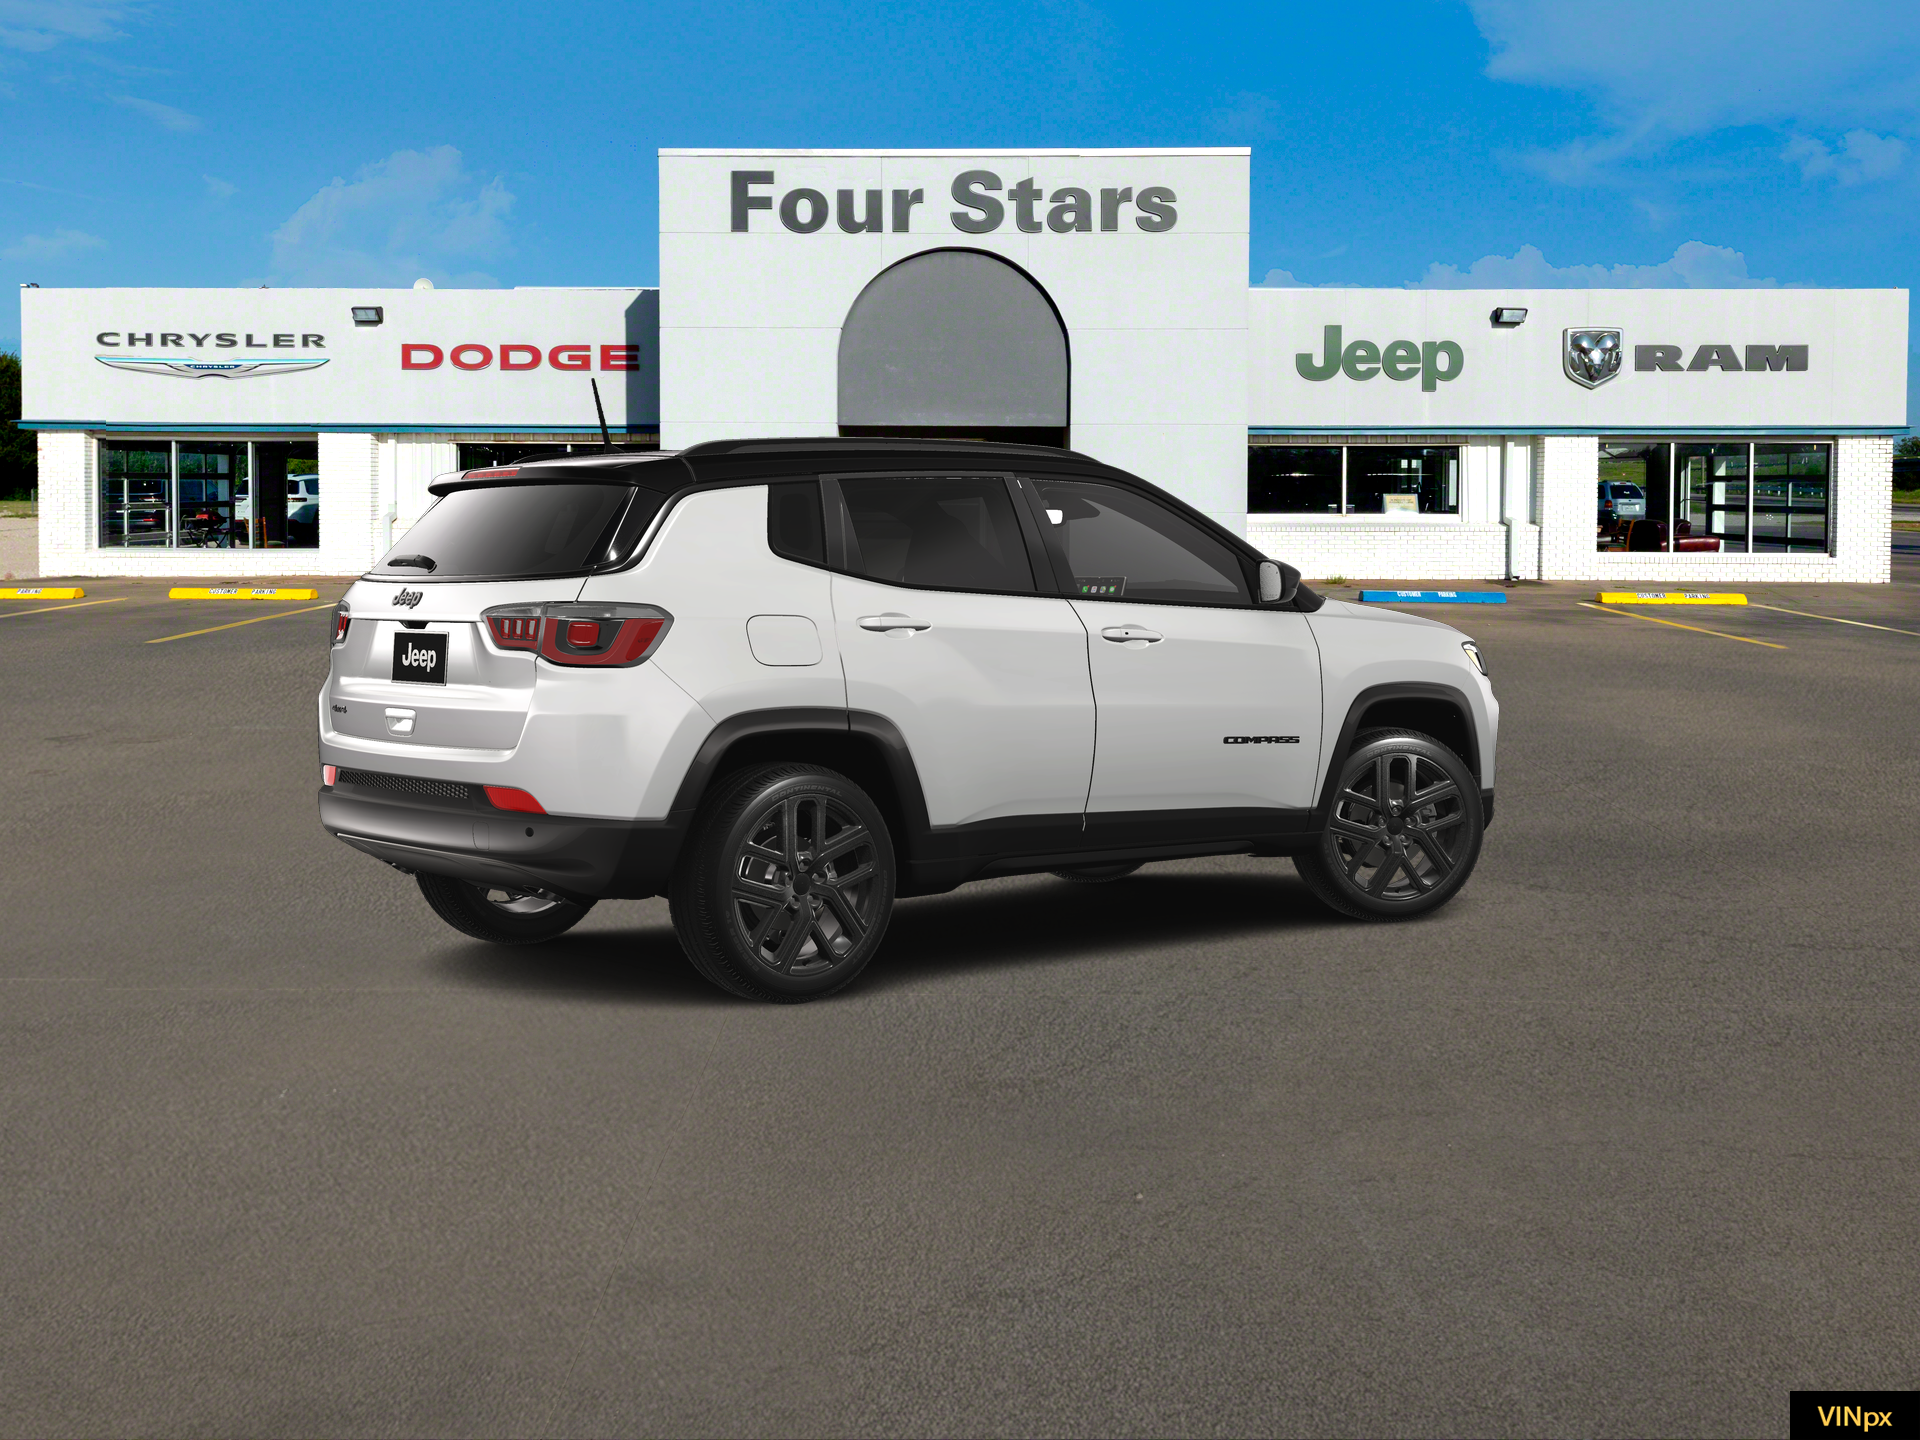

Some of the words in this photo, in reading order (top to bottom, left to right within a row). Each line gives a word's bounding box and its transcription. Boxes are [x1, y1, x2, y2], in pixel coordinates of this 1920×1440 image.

[731, 170, 925, 234] Four
[950, 169, 1178, 234] Stars
[96, 332, 326, 348] CHRYSLER
[401, 343, 640, 371] DODGE
[1295, 324, 1464, 392] Jeep
[1634, 344, 1809, 372] RAM
[391, 587, 423, 609] Jeep
[402, 642, 437, 672] Jeep
[1223, 736, 1300, 744] COMPASS
[771, 784, 842, 802] CONTINENTAL
